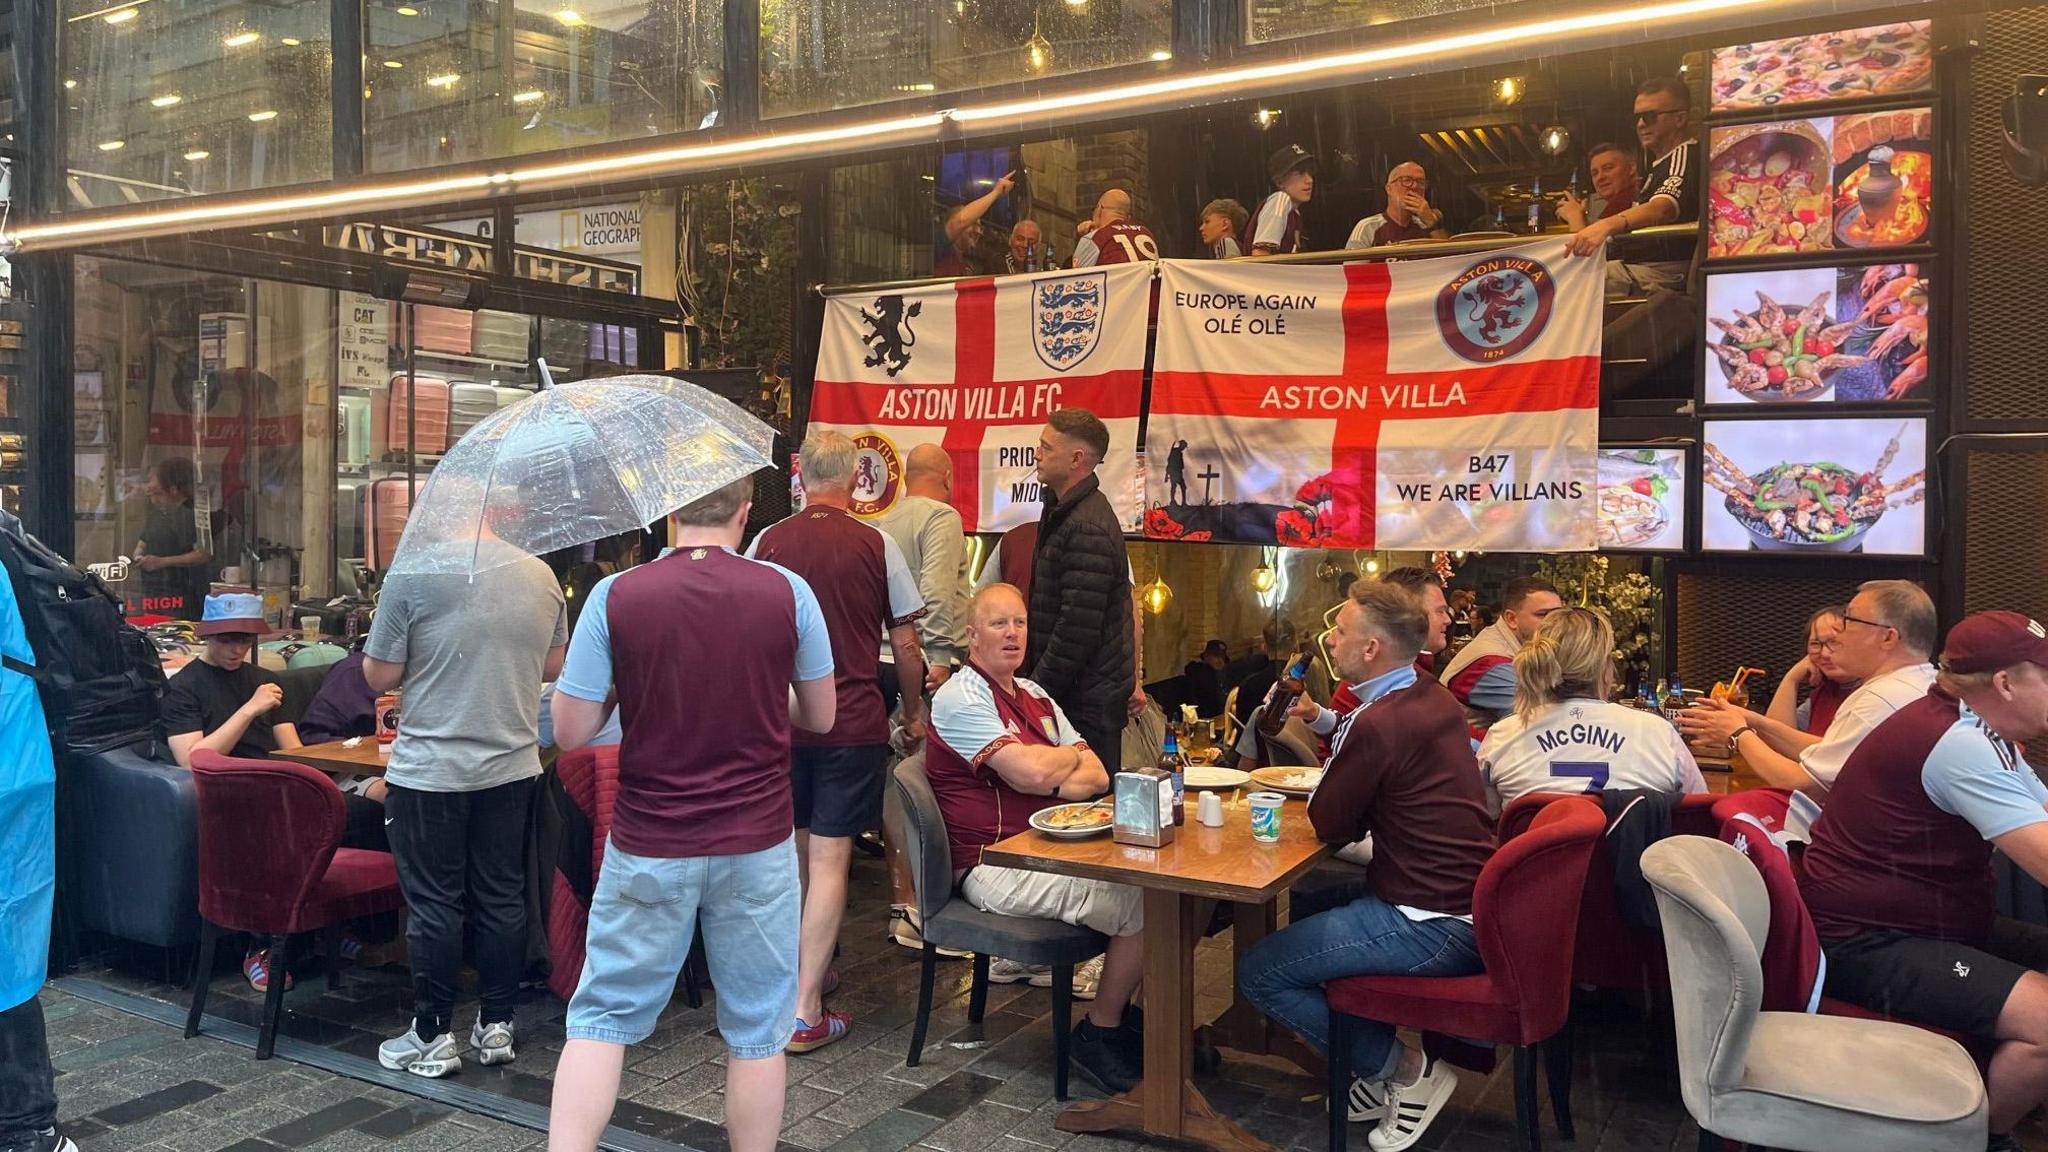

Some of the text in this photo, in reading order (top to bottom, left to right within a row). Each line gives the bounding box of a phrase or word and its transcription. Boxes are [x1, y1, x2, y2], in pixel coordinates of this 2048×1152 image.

[584, 210, 640, 228] NATIONAL
[1449, 259, 1544, 292] ASTON VILLA
[1175, 291, 1317, 310] EUROPE AGAIN
[354, 307, 375, 324] CAT
[1204, 314, 1286, 335] OLÉ OLÉ
[878, 383, 1062, 420] ASTON VILLA FC
[1259, 382, 1467, 410] ASTON VILLA
[876, 440, 899, 482] VILLA
[1468, 455, 1510, 473] B47
[1397, 481, 1582, 501] WE ARE VILLANS
[1536, 723, 1626, 754] McGINN
